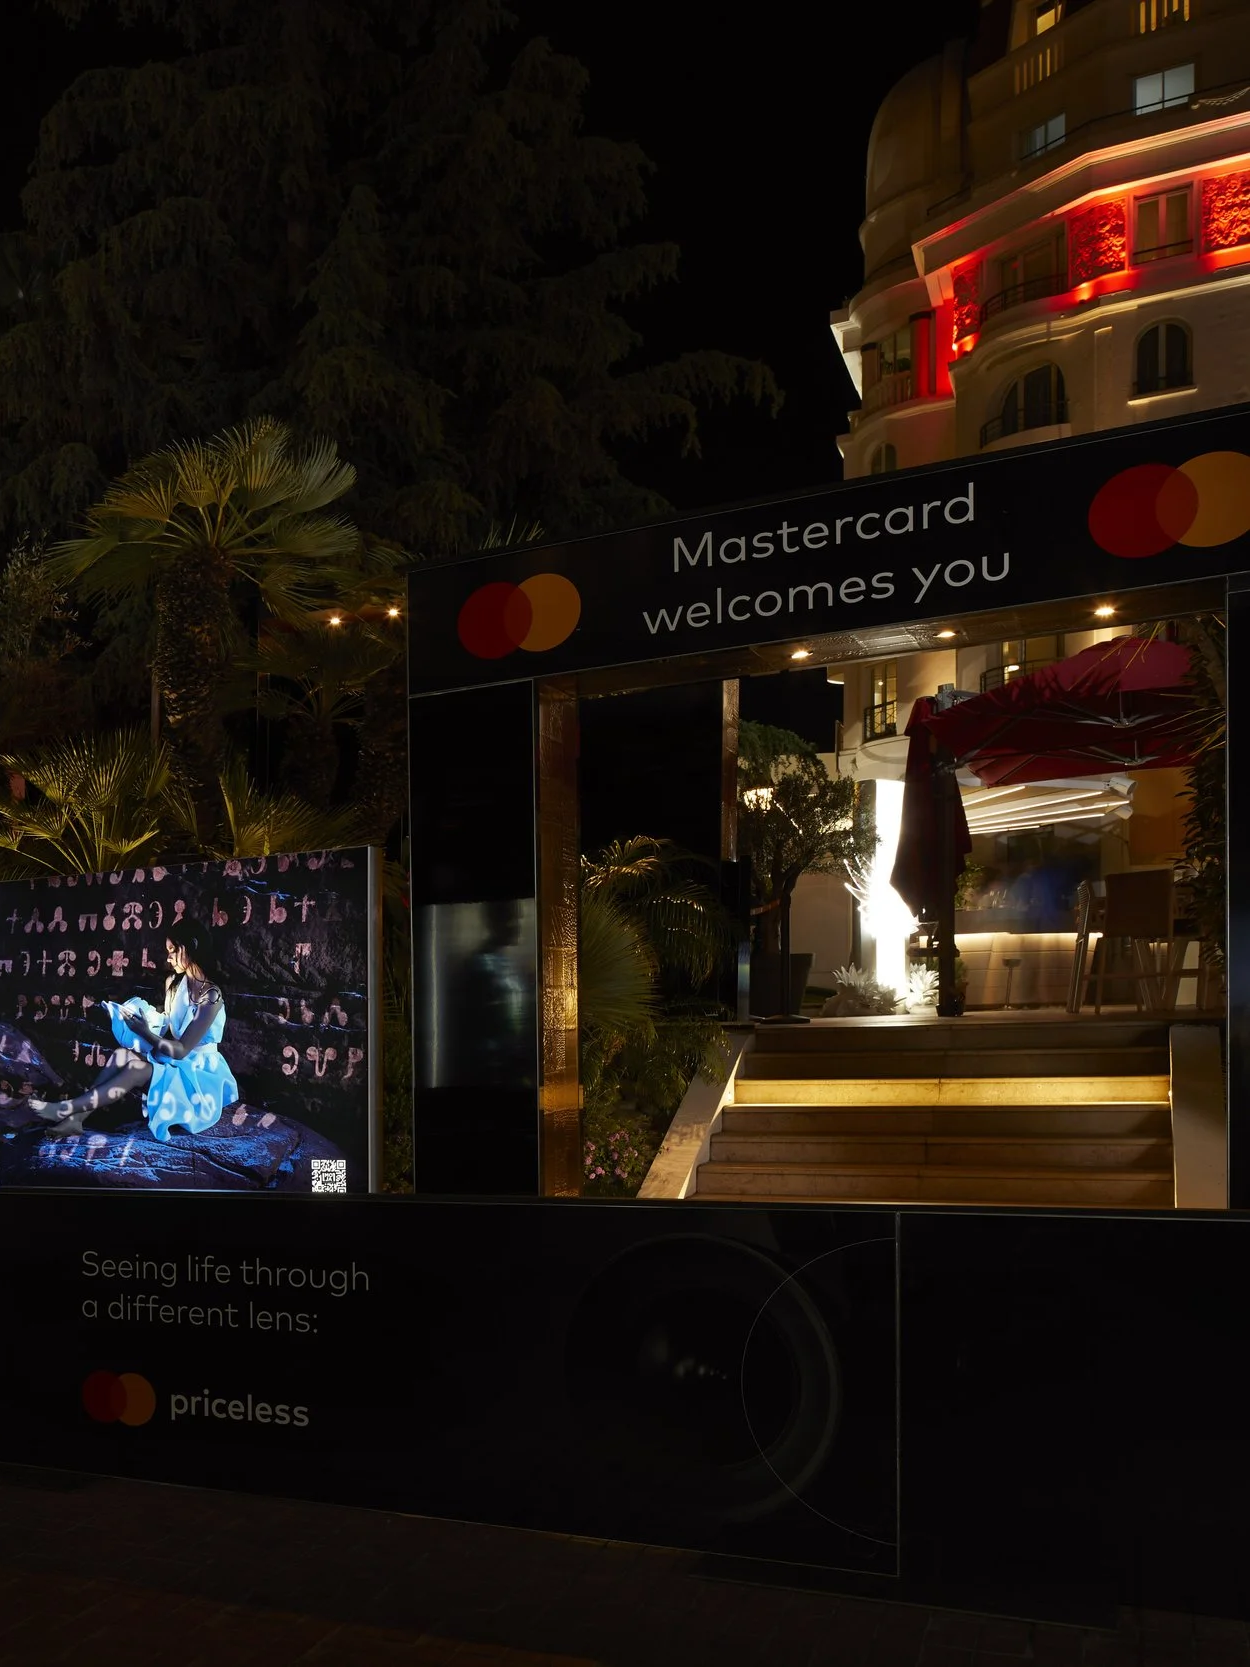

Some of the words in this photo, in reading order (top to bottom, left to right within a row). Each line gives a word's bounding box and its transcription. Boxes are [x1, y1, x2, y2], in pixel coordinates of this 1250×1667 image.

[672, 481, 976, 573] Mastercard
[642, 569, 896, 635] welcomes
[911, 551, 1011, 604] you
[81, 1251, 178, 1288] Seeing
[187, 1254, 231, 1285] life
[239, 1257, 370, 1298] through
[81, 1299, 98, 1320] a
[107, 1293, 239, 1328] different
[249, 1301, 318, 1334] lens:
[170, 1388, 310, 1428] priceless
